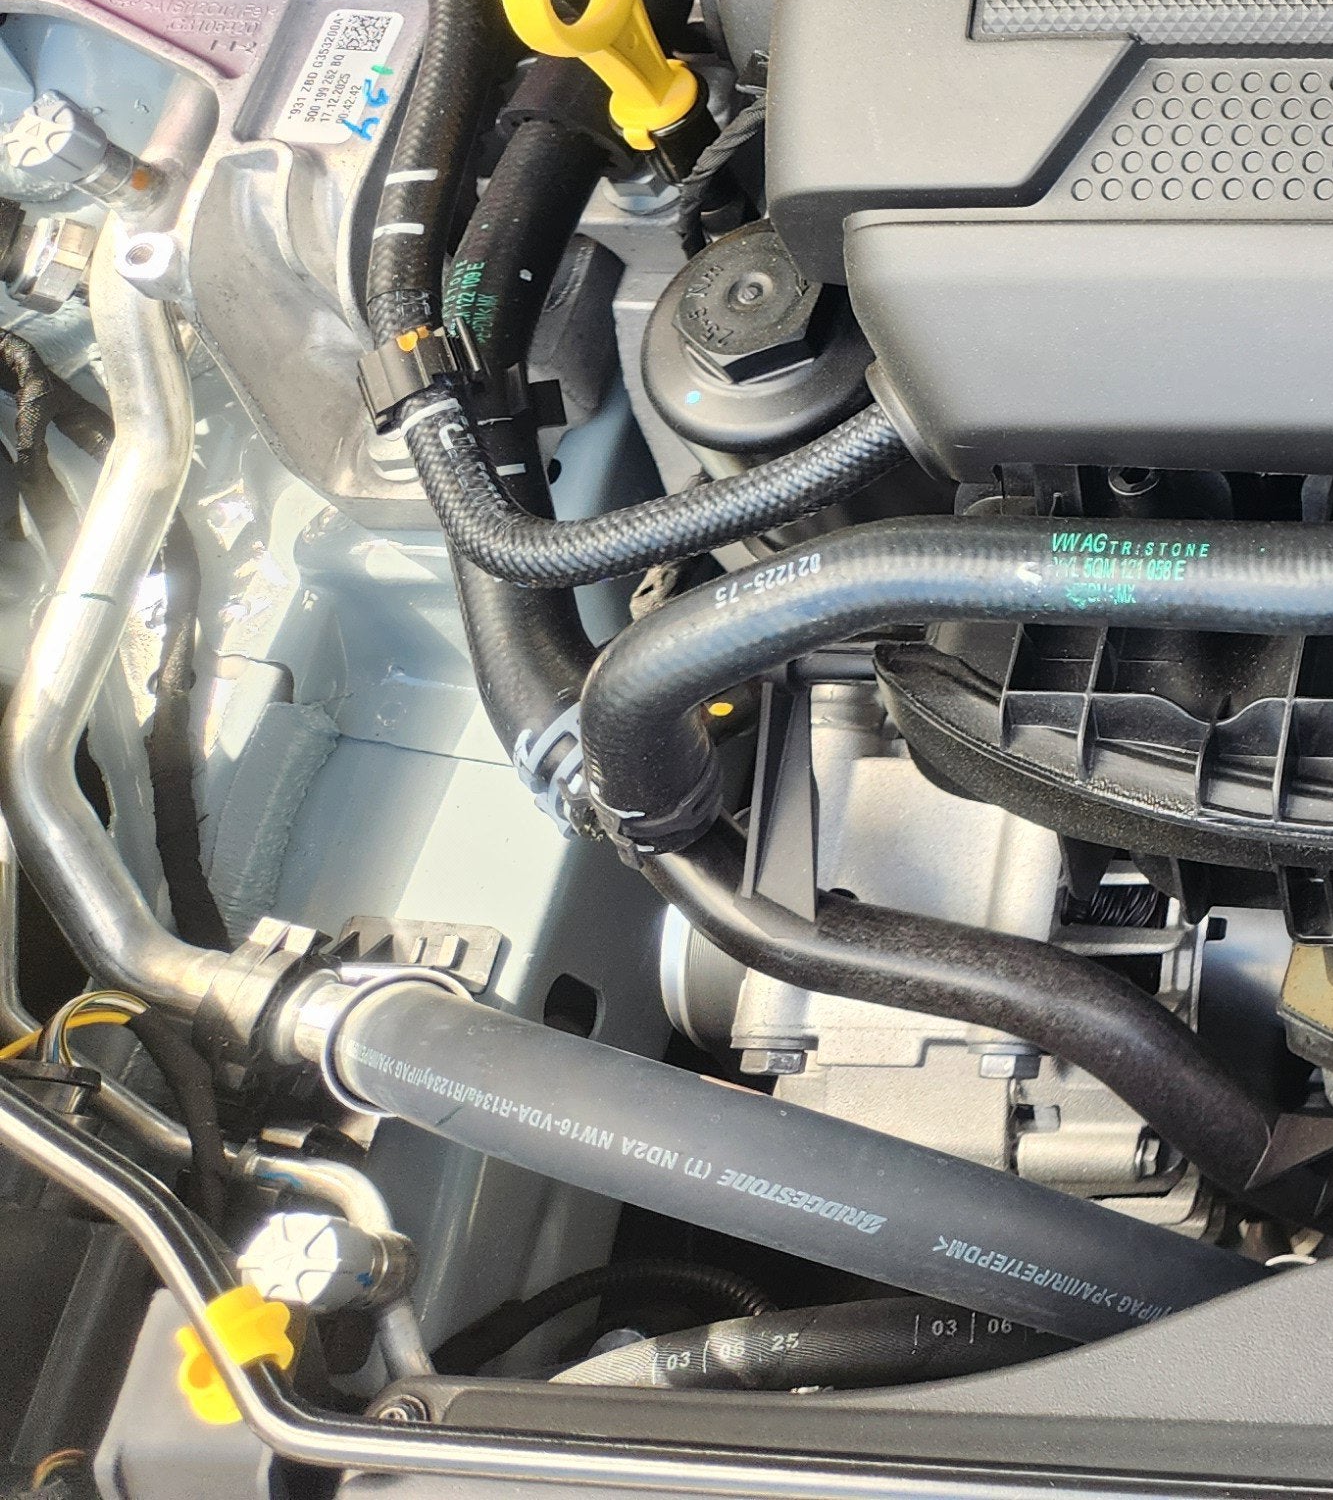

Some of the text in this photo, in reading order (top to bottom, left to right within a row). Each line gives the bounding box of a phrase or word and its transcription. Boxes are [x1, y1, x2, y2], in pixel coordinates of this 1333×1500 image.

[321, 68, 337, 85] 262
[314, 86, 329, 102] 199
[319, 72, 351, 123] 17.12.2025
[466, 259, 485, 272] E
[1051, 532, 1081, 552] VW
[1079, 533, 1107, 552] AG
[711, 552, 823, 609] 021225-75
[1173, 560, 1186, 580] E
[618, 1135, 679, 1170] ND2A
[682, 1154, 712, 1181] (T)
[716, 1167, 887, 1234] BRIDGESTONE
[930, 1317, 1013, 1338] 03 06
[665, 1352, 691, 1370] 03
[770, 1332, 801, 1351] 25
